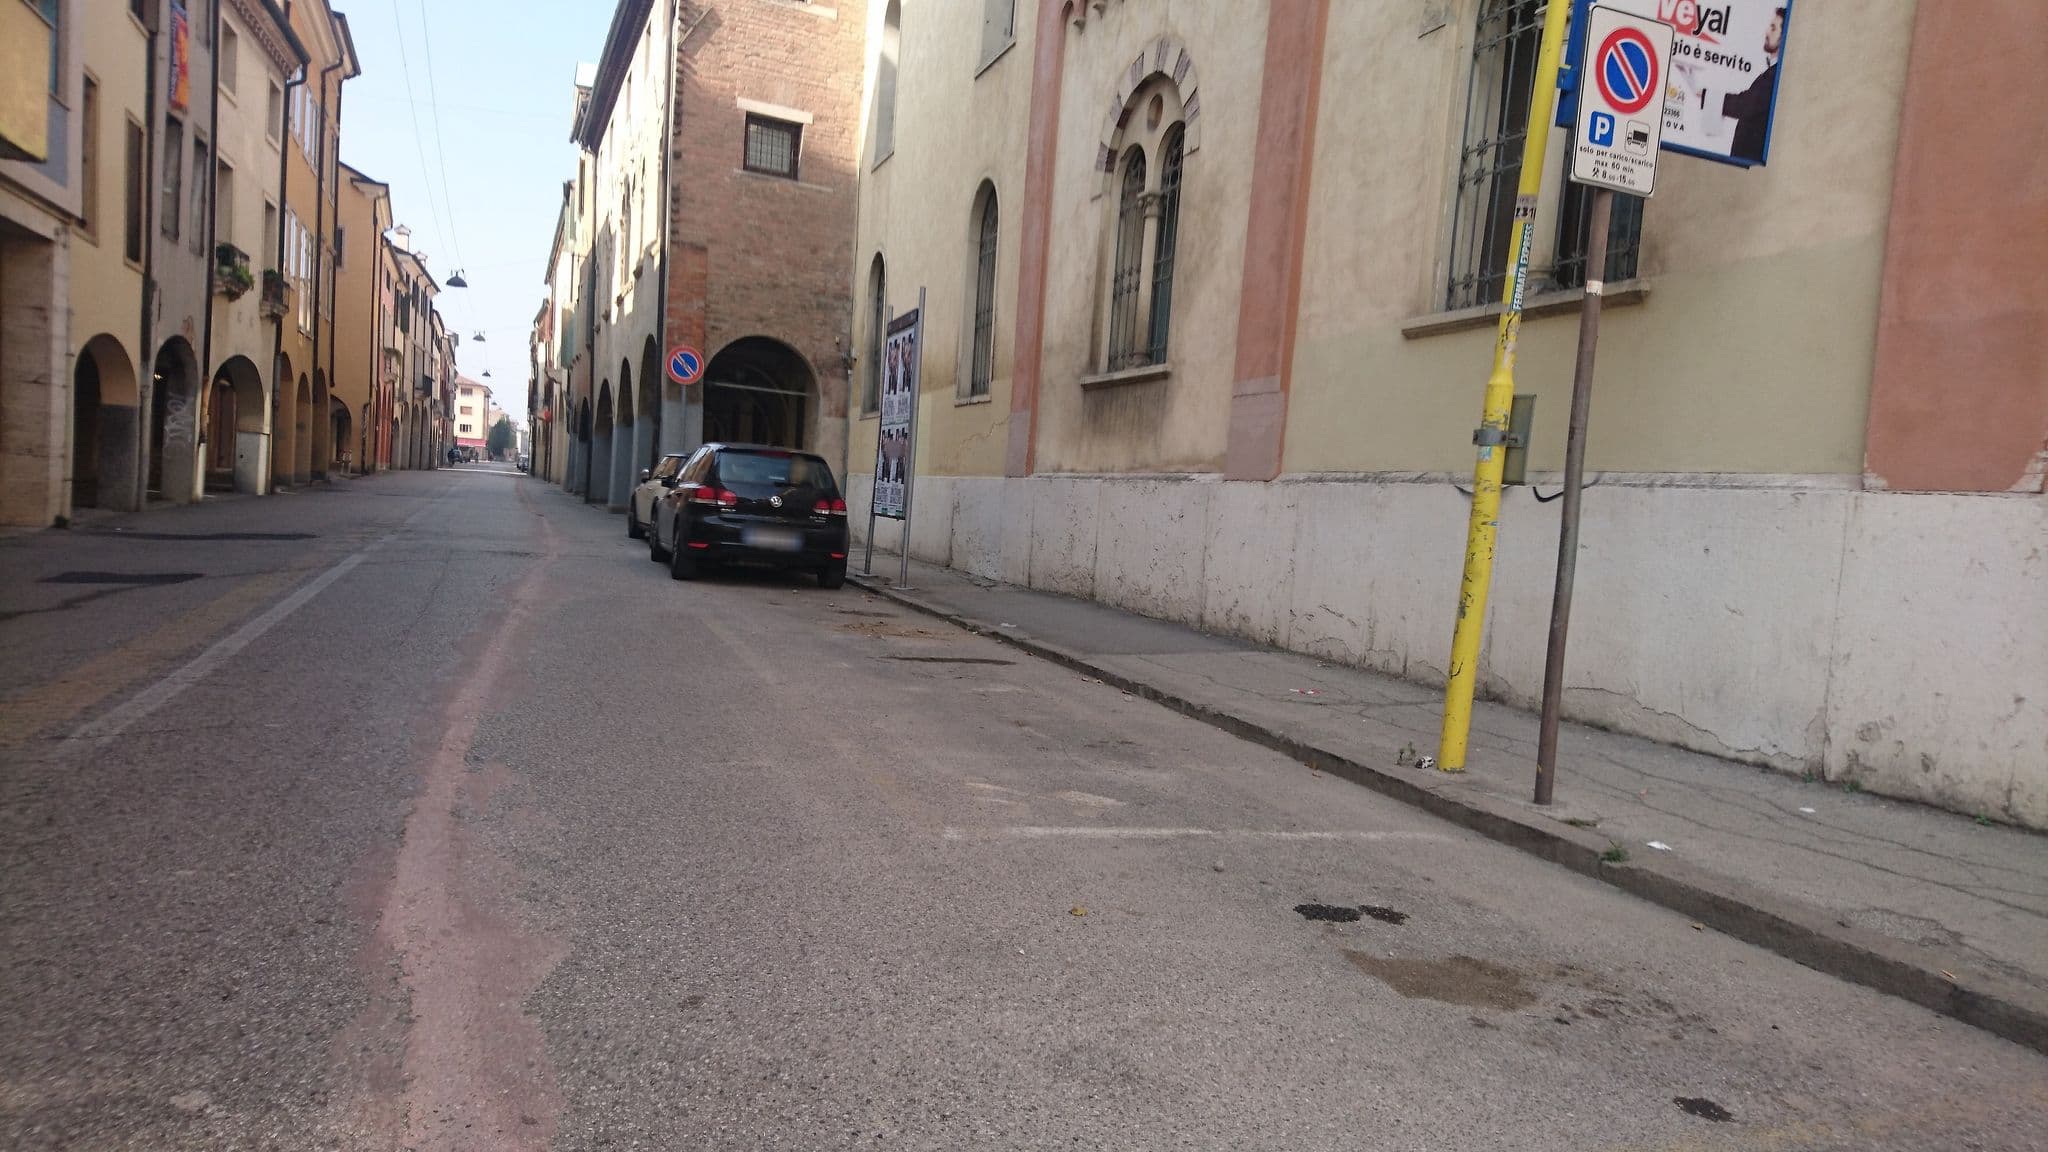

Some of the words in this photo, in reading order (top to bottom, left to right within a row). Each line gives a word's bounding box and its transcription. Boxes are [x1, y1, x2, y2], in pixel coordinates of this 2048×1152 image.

[1704, 50, 1751, 72] servito
[1594, 116, 1610, 141] P
[1580, 146, 1594, 154] solo
[1596, 149, 1607, 157] per
[1622, 165, 1634, 174] min
[1513, 266, 1528, 311] FERMATA
